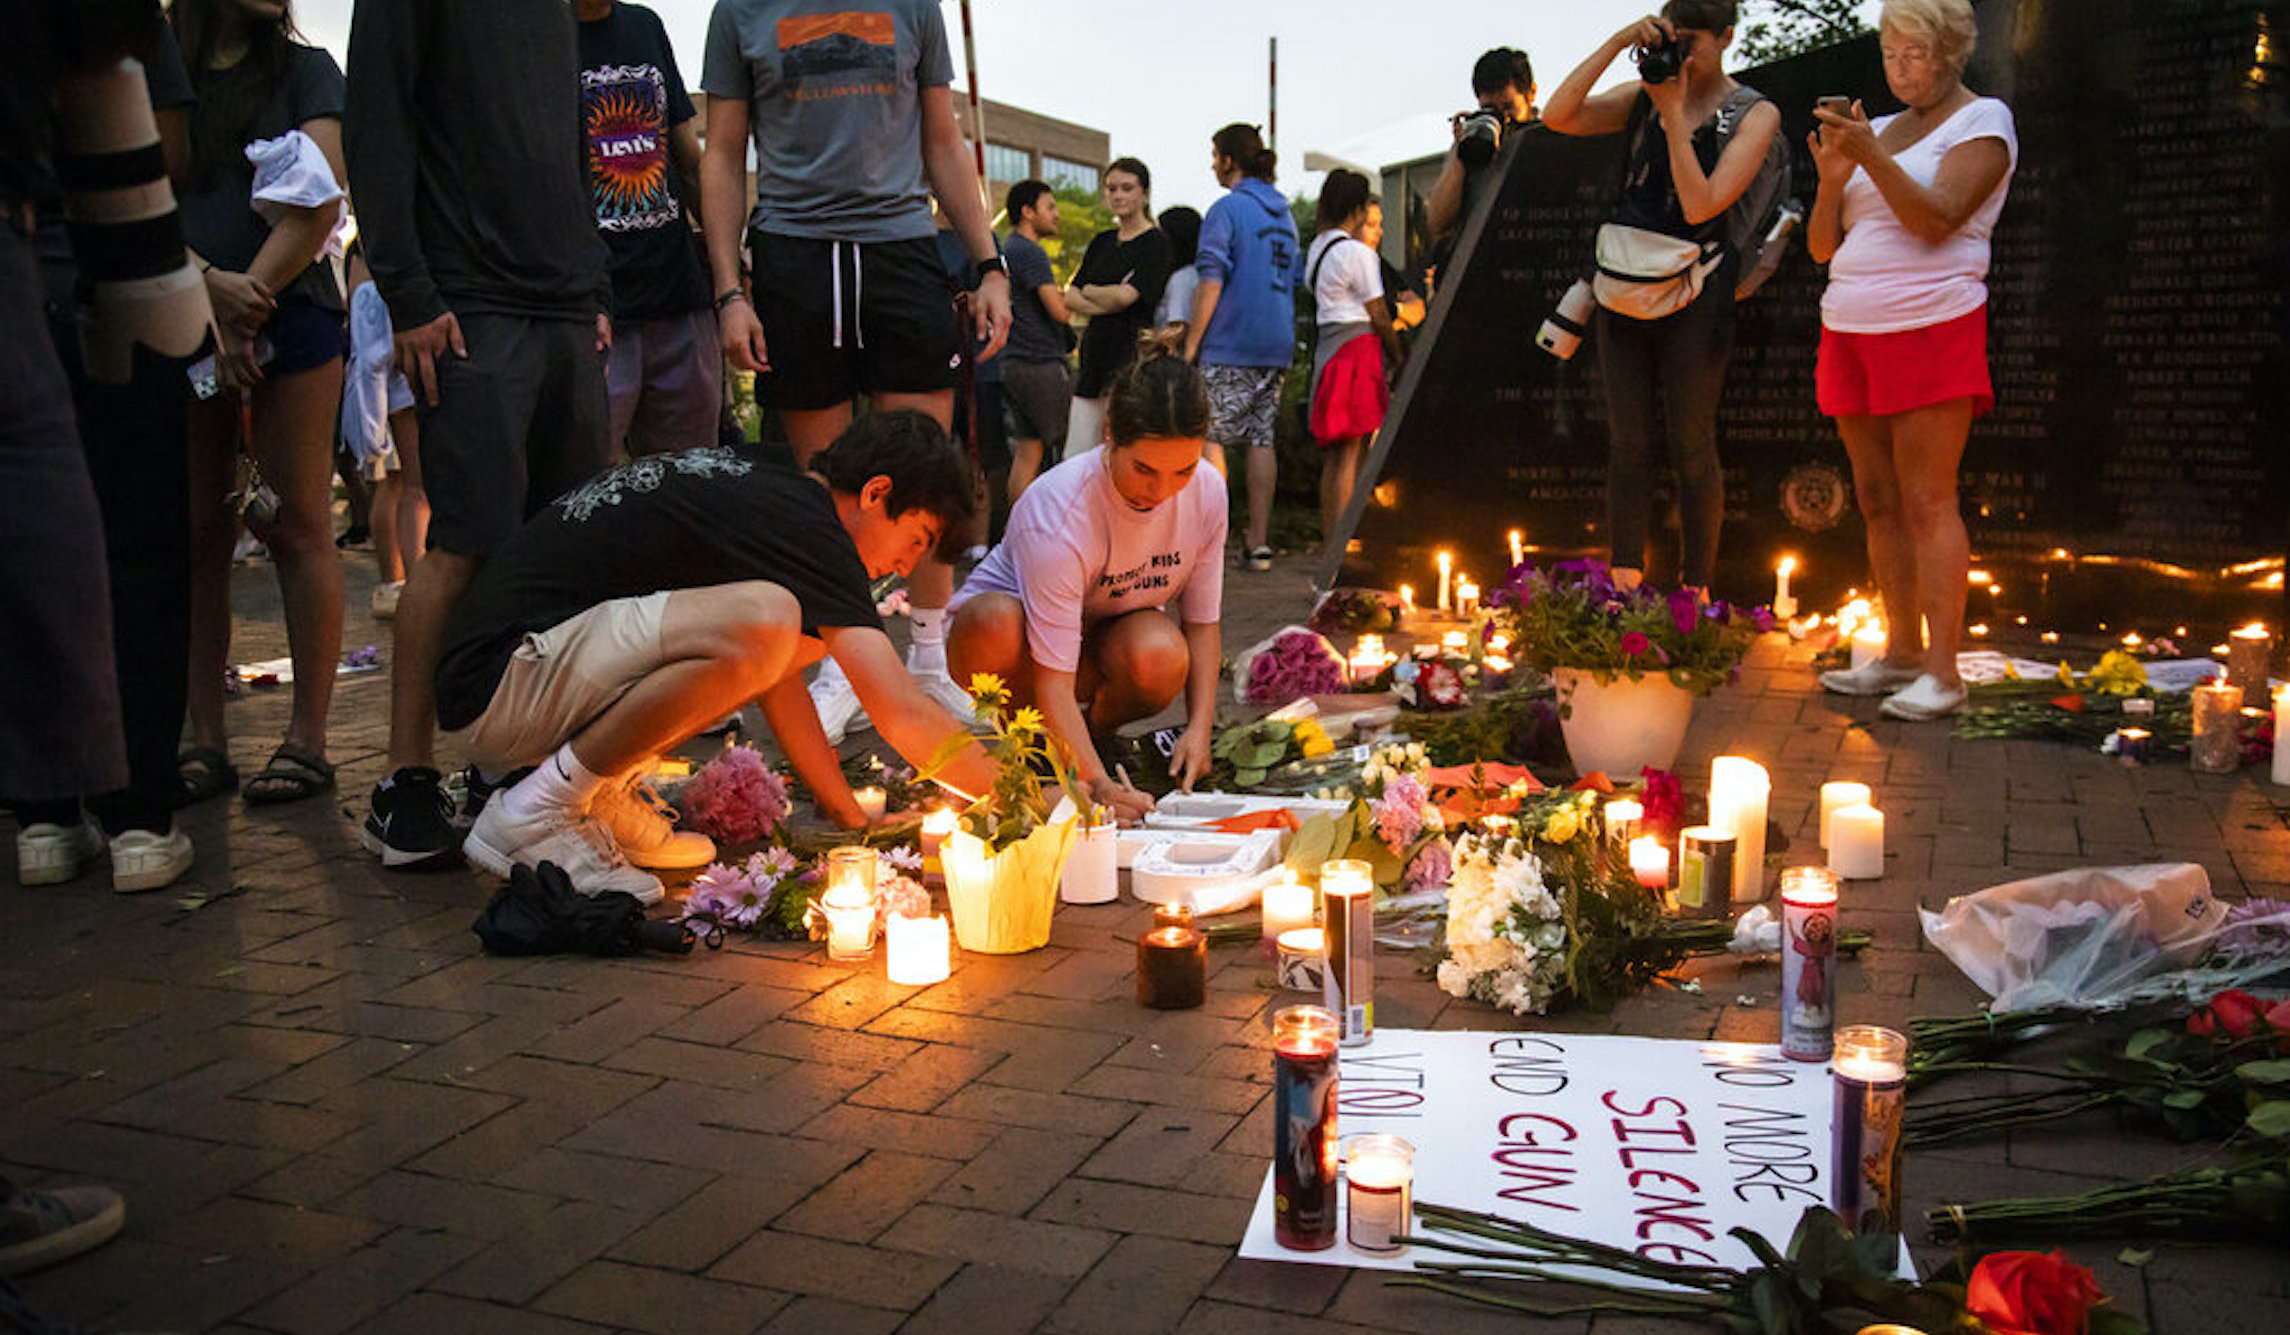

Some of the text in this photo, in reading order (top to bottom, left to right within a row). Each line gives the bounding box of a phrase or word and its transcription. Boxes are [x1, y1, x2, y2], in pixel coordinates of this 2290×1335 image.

[600, 133, 657, 157] Levi's
[1133, 573, 1169, 590] GUNS
[1151, 551, 1181, 568] KIDS
[1488, 1037, 1583, 1213] END GUN
[1717, 1102, 1824, 1202] MORE
[1600, 1089, 1719, 1265] SILENCE
